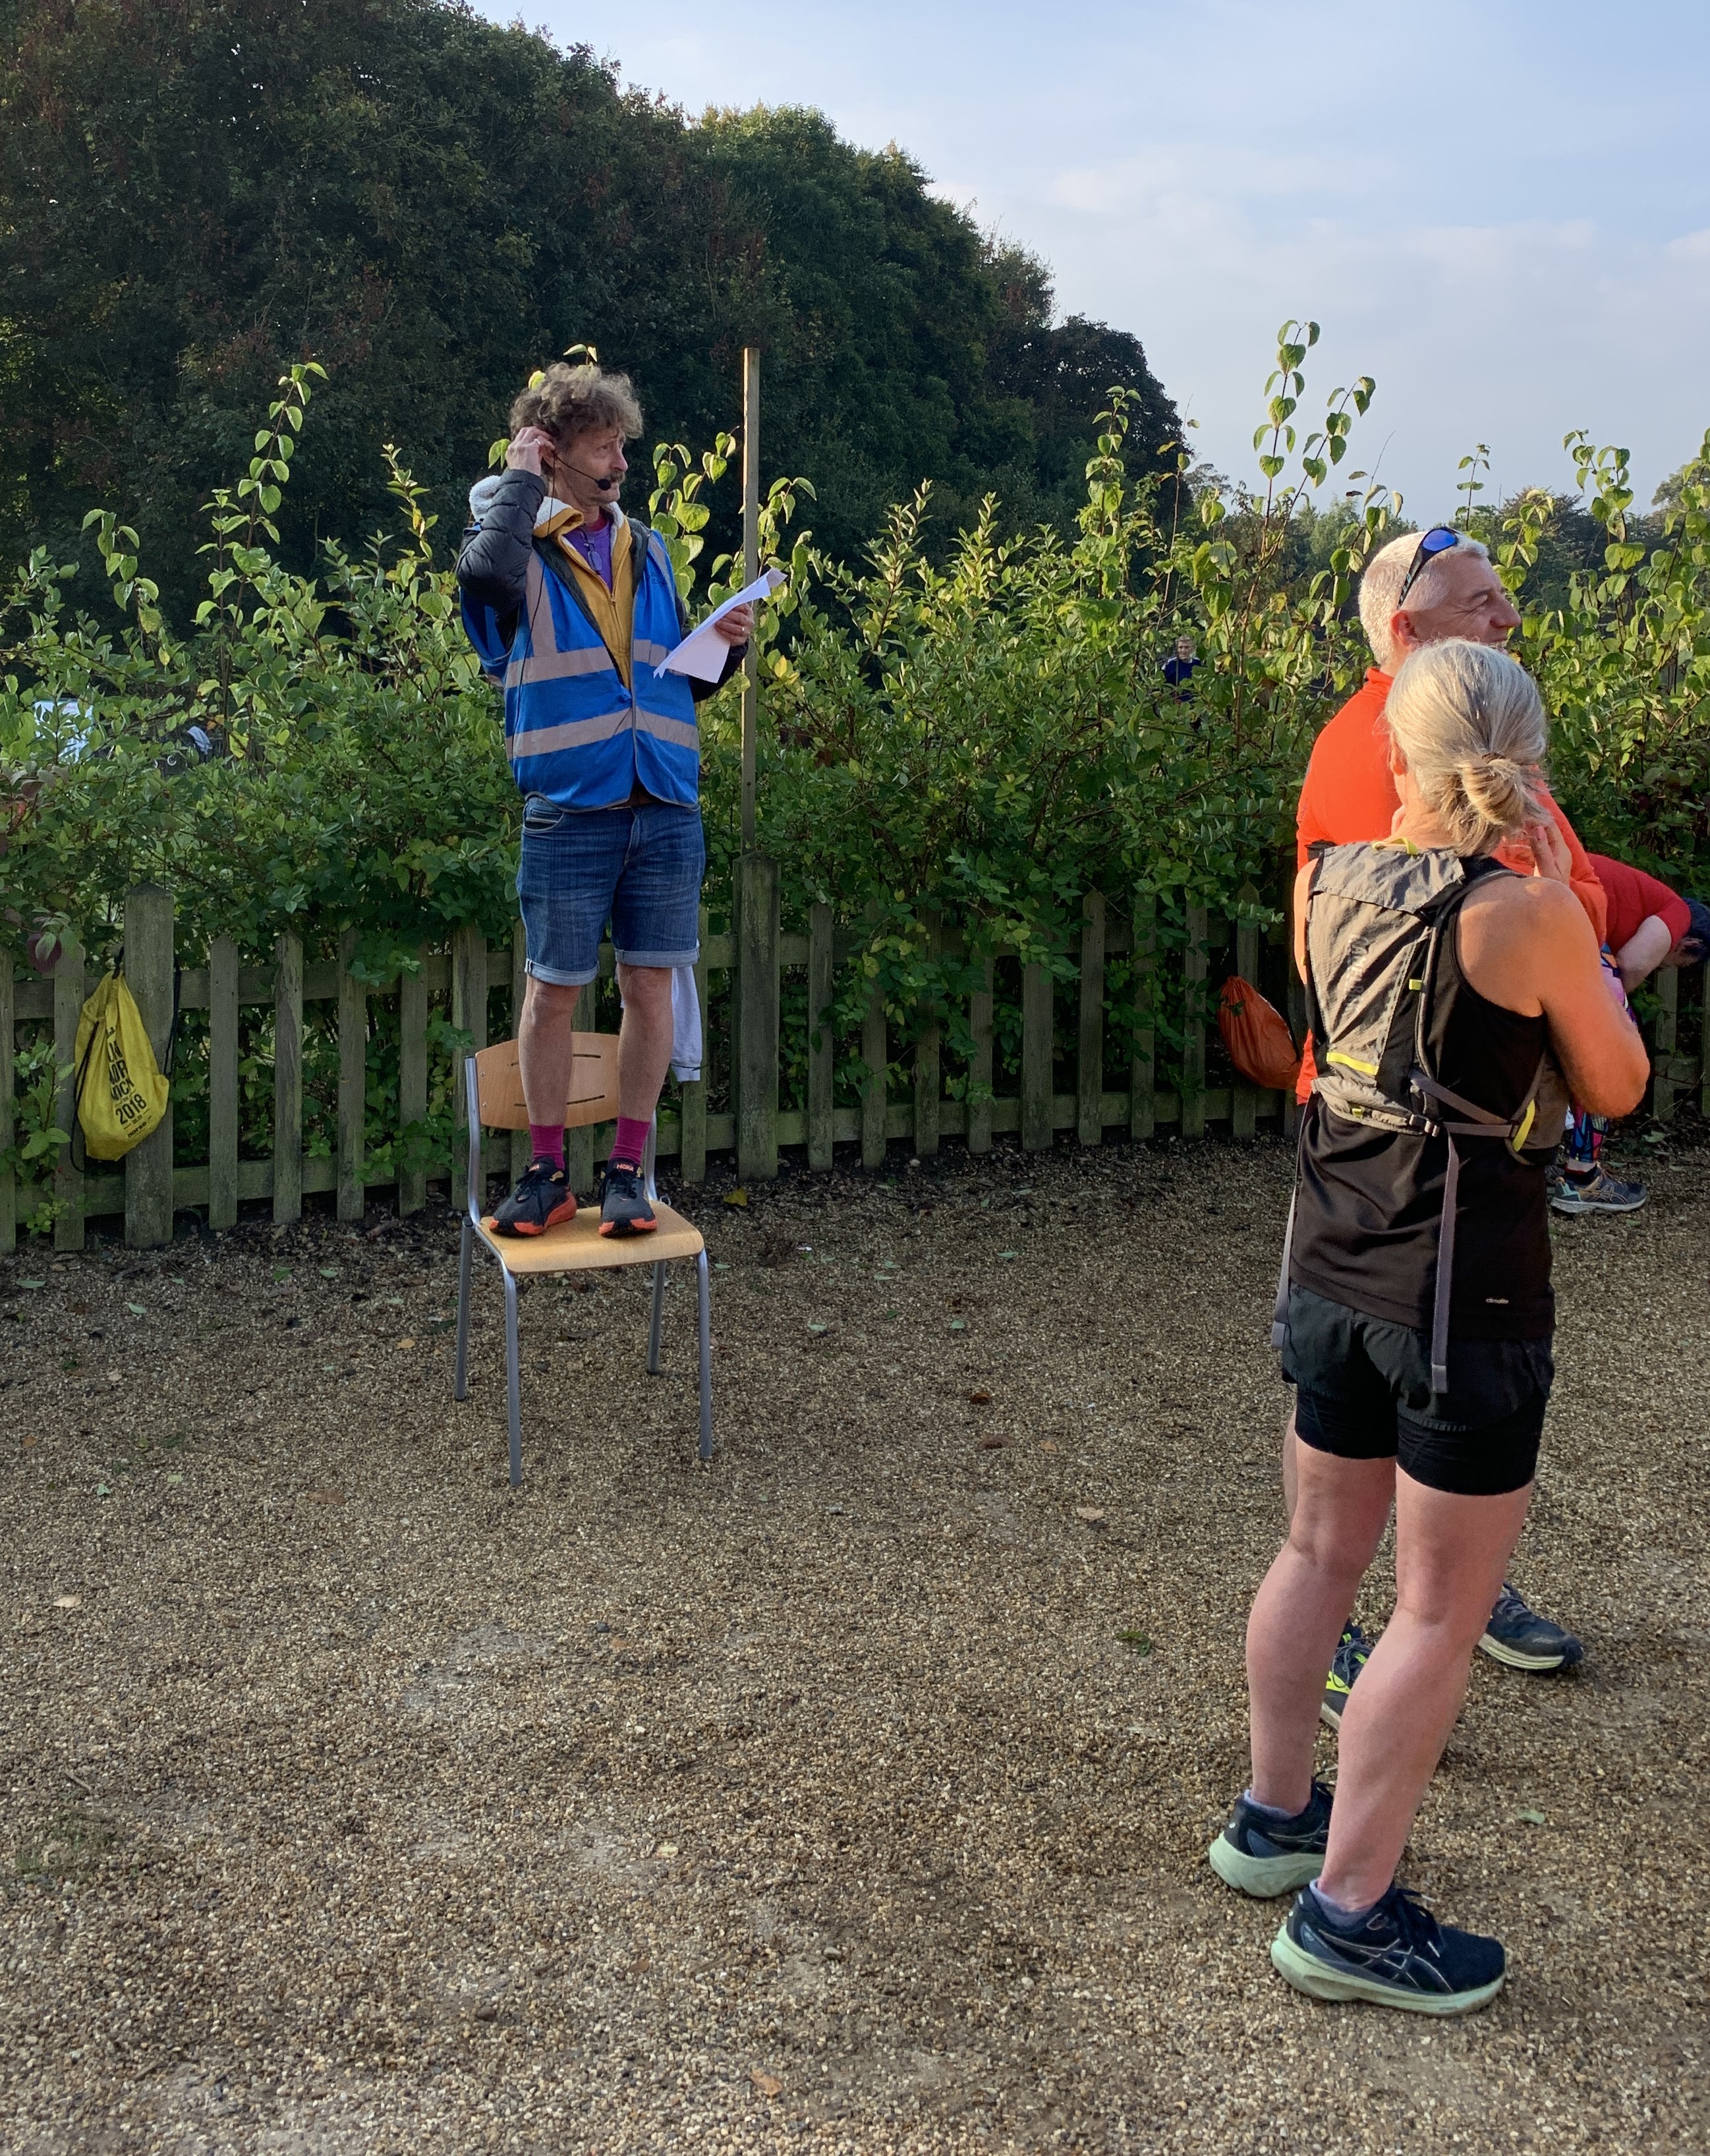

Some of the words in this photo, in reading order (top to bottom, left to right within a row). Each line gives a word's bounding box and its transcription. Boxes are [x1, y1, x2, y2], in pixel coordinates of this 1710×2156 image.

[115, 1094, 147, 1125] 2018
[128, 1121, 147, 1138] norse
[616, 1163, 635, 1172] HOKA
